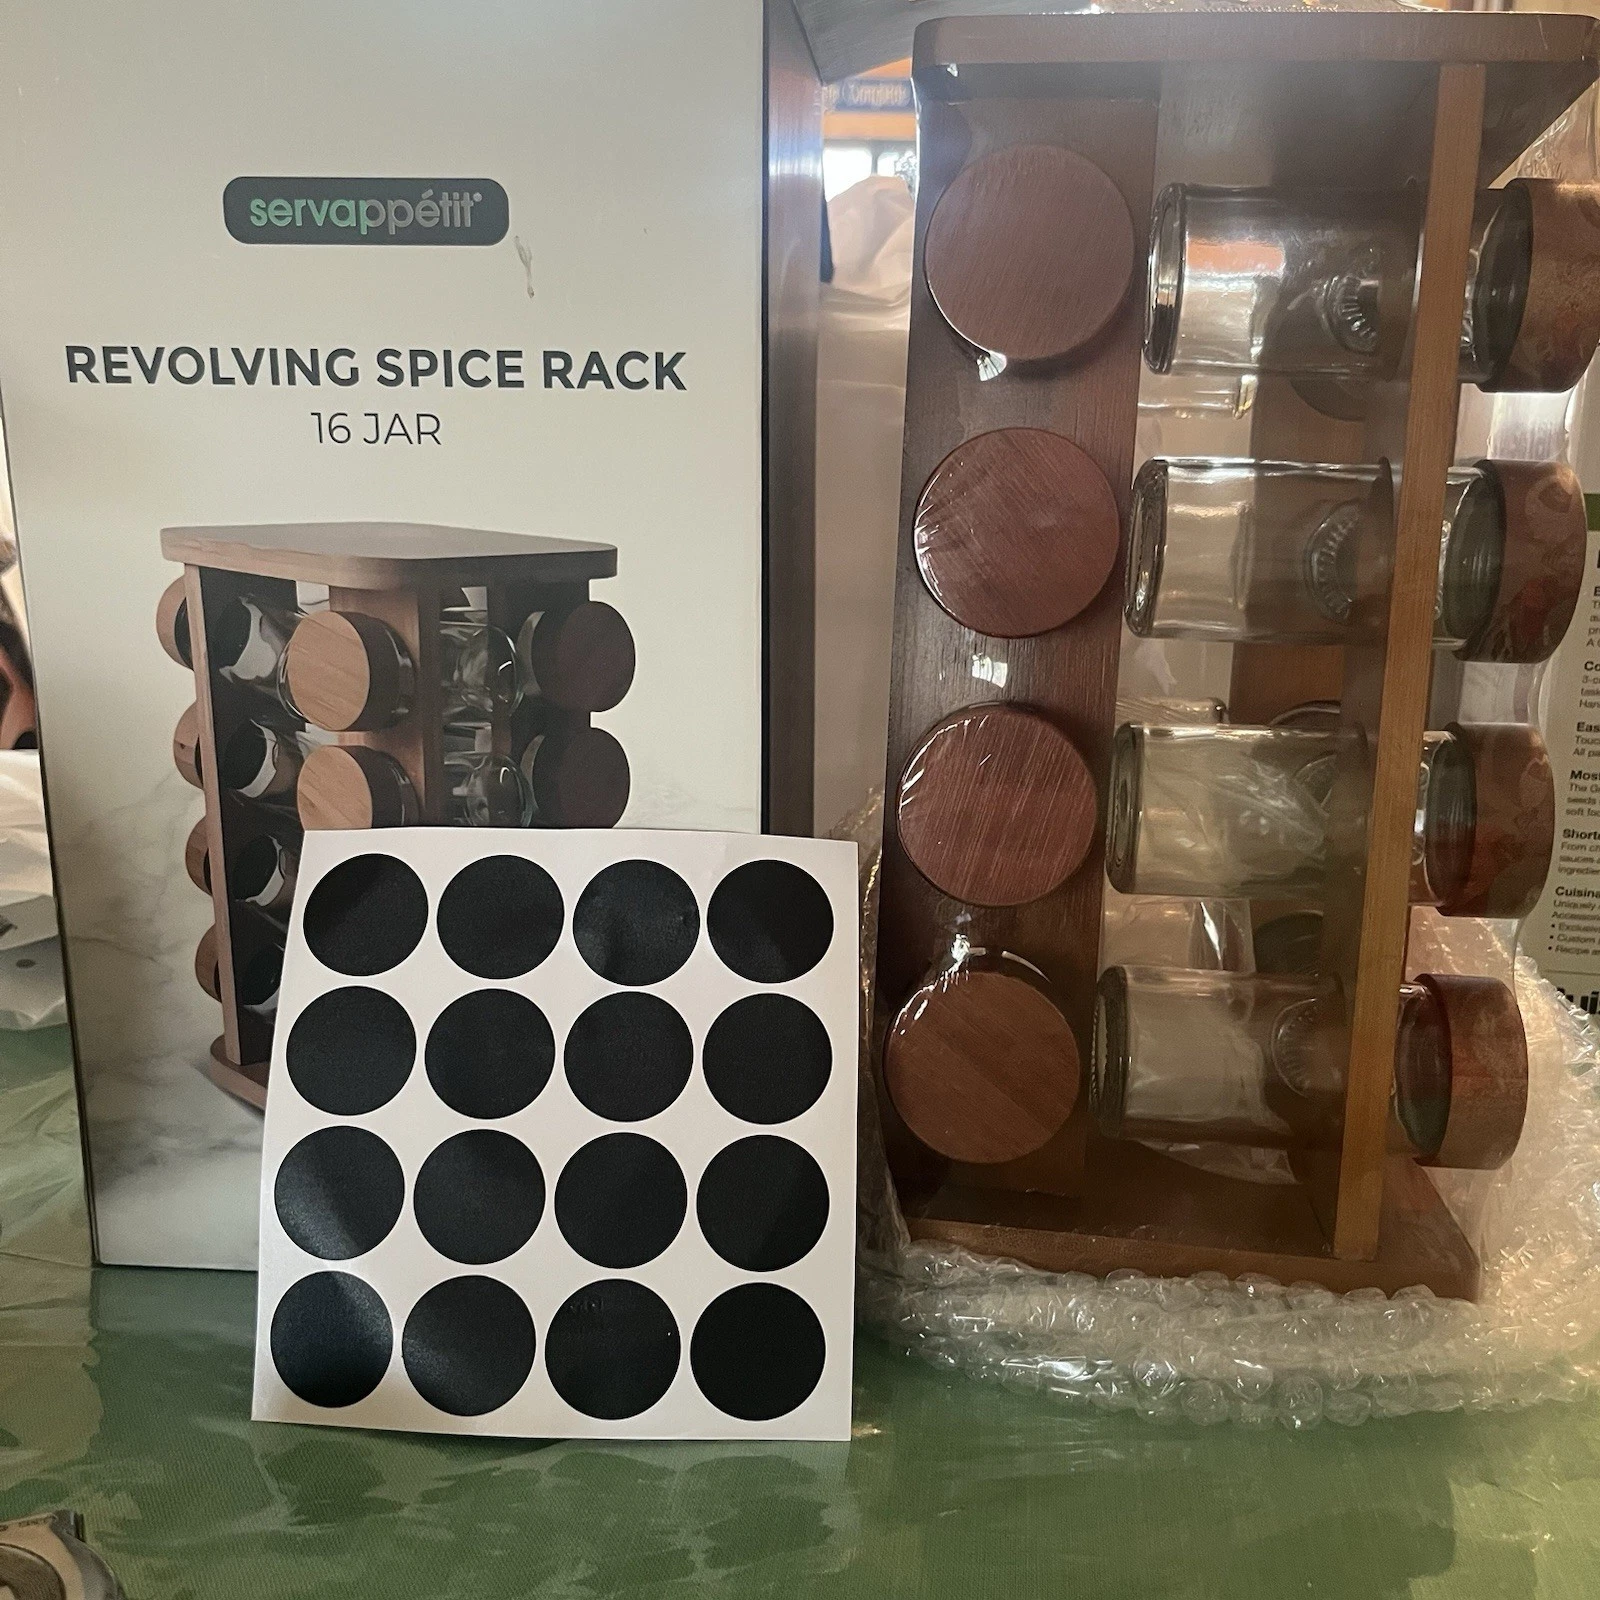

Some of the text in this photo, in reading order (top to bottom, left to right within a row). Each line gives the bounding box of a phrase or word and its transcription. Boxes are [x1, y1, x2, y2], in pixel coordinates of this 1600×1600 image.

[65, 345, 687, 391] REVOLVING SPICE RACK
[310, 412, 442, 445] 16 JAR
